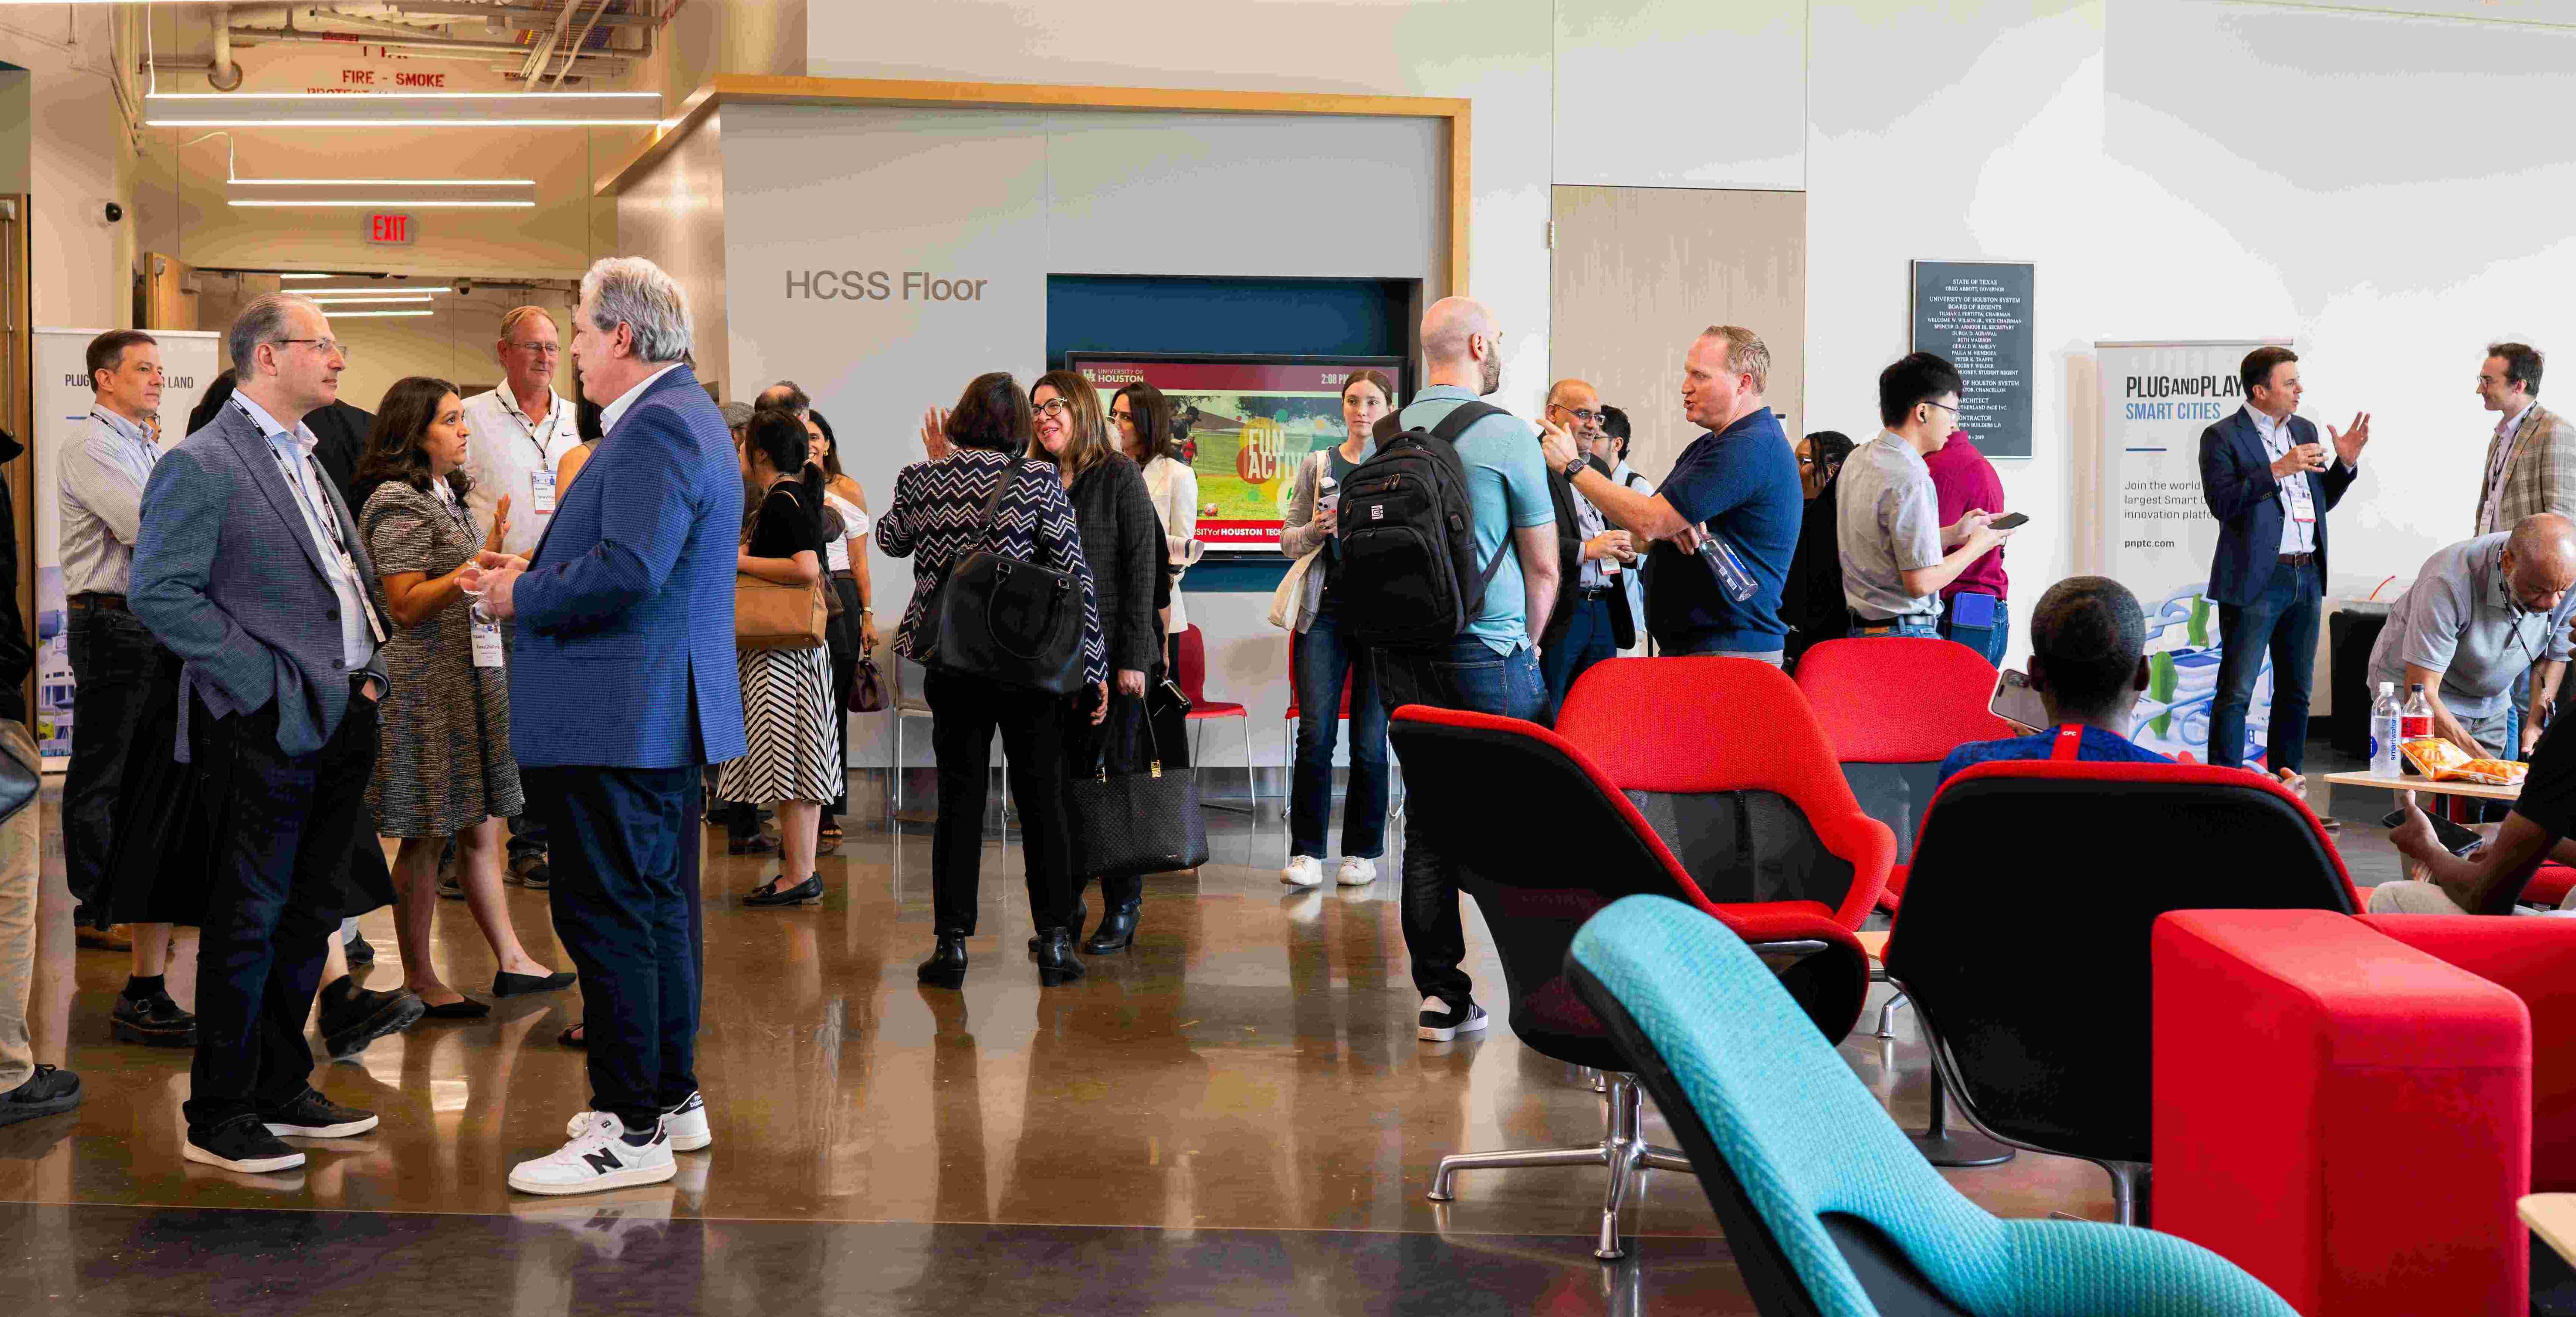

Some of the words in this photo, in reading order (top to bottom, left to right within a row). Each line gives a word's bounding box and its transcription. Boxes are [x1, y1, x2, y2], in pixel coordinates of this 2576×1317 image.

[343, 70, 374, 84] FIRE
[396, 73, 445, 87] SMOKE
[373, 214, 408, 243] EXIT
[786, 270, 890, 300] HCSS
[903, 272, 988, 301] Floor
[168, 376, 194, 389] LAND
[1321, 373, 1337, 384] 2:08
[2126, 402, 2174, 420] SMART
[2177, 402, 2221, 420] CITIES
[1249, 429, 1284, 456] FUN
[1248, 451, 1305, 479] ACTIV
[2125, 481, 2146, 490] Join
[2149, 481, 2166, 490] the
[2125, 495, 2162, 506] largest
[2165, 495, 2197, 504] Smart
[2125, 509, 2179, 518] innovation
[2183, 509, 2213, 520] platfo
[2125, 540, 2174, 548] pnptc.com
[582, 1147, 623, 1175] N
